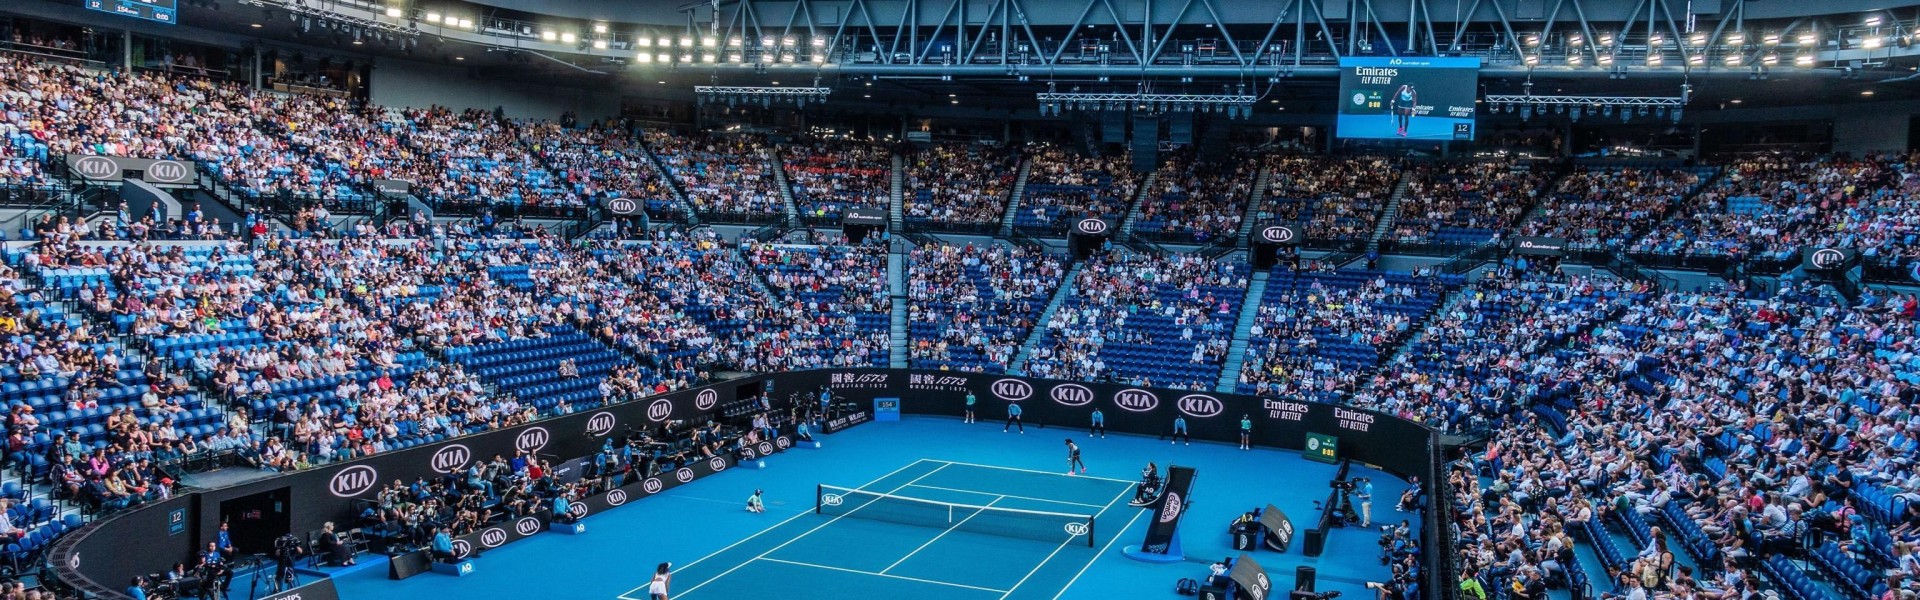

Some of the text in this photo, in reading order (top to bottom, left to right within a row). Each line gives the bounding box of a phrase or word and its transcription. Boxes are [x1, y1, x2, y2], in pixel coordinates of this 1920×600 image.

[1356, 66, 1398, 76] Emirates
[1361, 76, 1391, 85] FLY BETTER
[1457, 124, 1468, 132] 12
[83, 160, 111, 174] KIA
[155, 164, 181, 178] KIA
[613, 201, 632, 211] KIA
[1083, 221, 1102, 231] KIA
[1267, 229, 1288, 239] KIA
[998, 382, 1026, 397] KIA
[1058, 387, 1086, 402] KIA
[1121, 393, 1151, 408] KIA
[1185, 398, 1216, 413] KIA
[1264, 398, 1309, 413] Emirates
[651, 402, 668, 418] KIA
[1270, 409, 1302, 421] FLY BETTER
[1334, 407, 1374, 423] Emirates
[1340, 419, 1369, 432] FLY BETTER
[521, 431, 544, 449] KIA
[438, 449, 464, 469] KIA
[338, 470, 369, 492] KIA
[172, 511, 181, 522] 12
